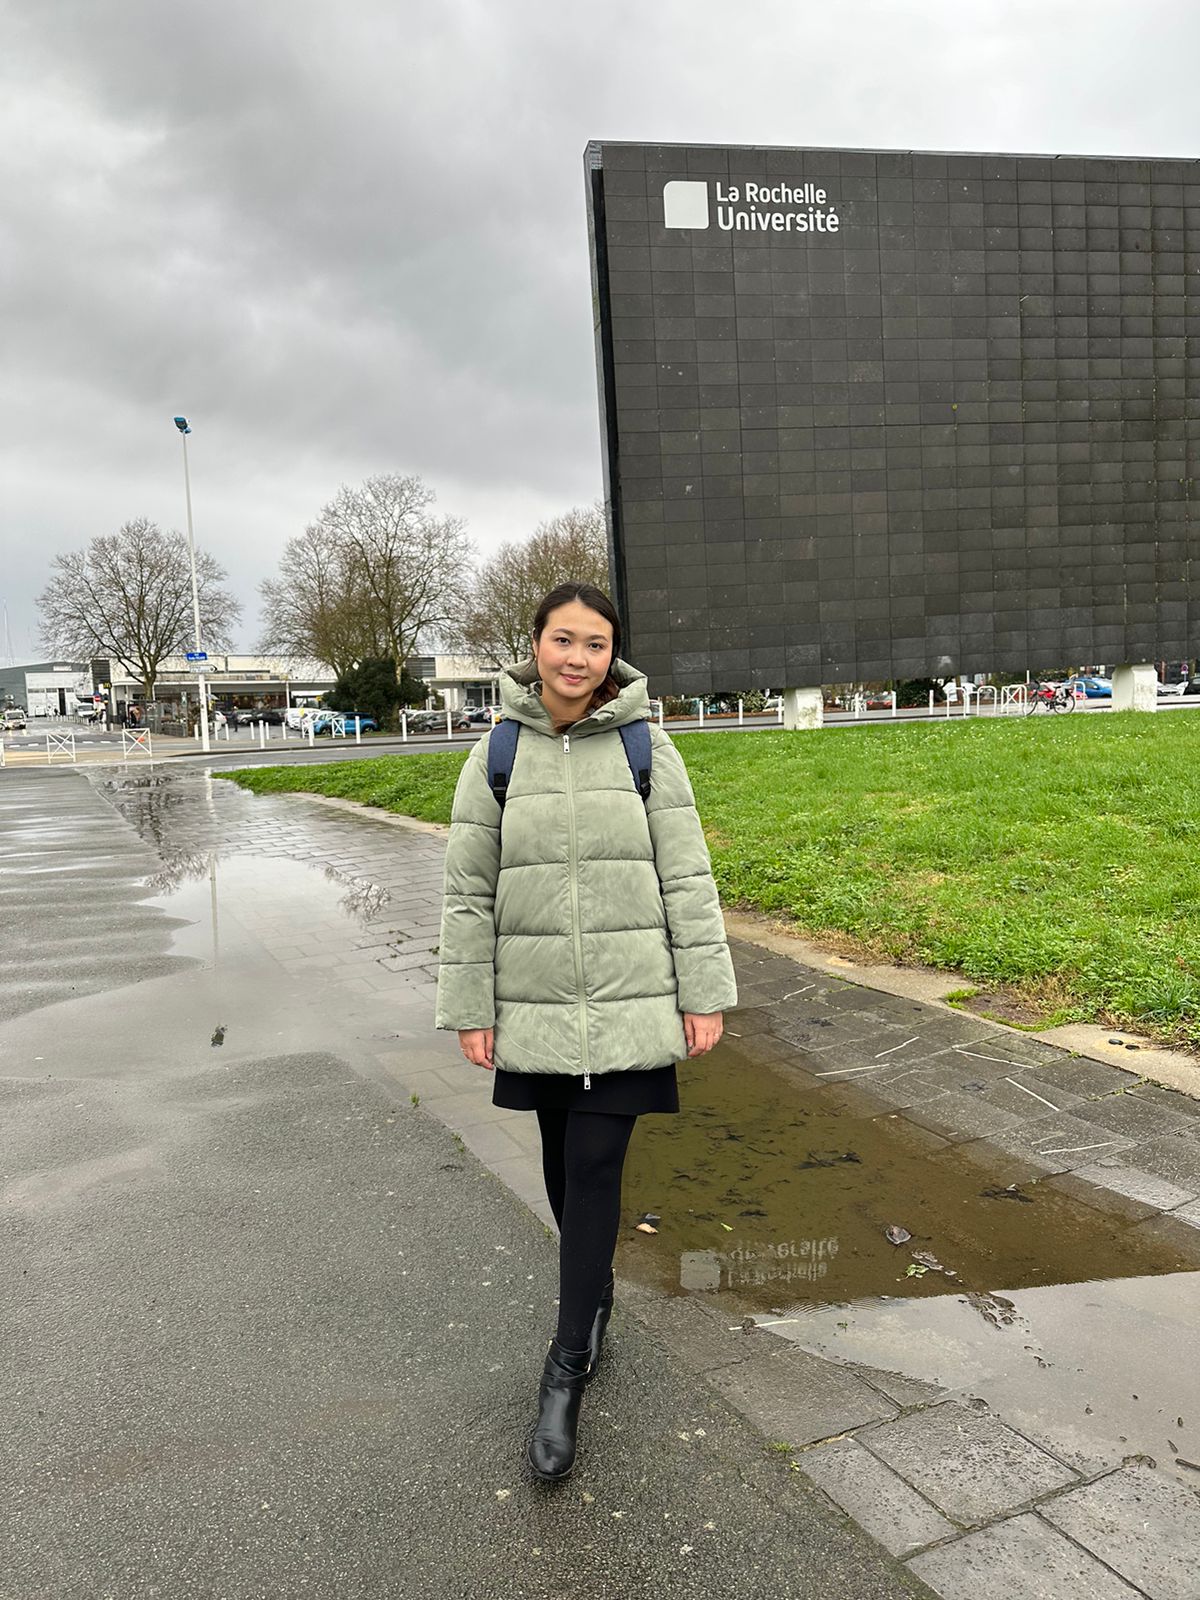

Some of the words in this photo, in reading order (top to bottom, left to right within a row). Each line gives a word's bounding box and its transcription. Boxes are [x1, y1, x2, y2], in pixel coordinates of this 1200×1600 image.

[717, 181, 740, 203] La
[745, 182, 827, 205] Rochelle
[717, 204, 840, 233] Université
